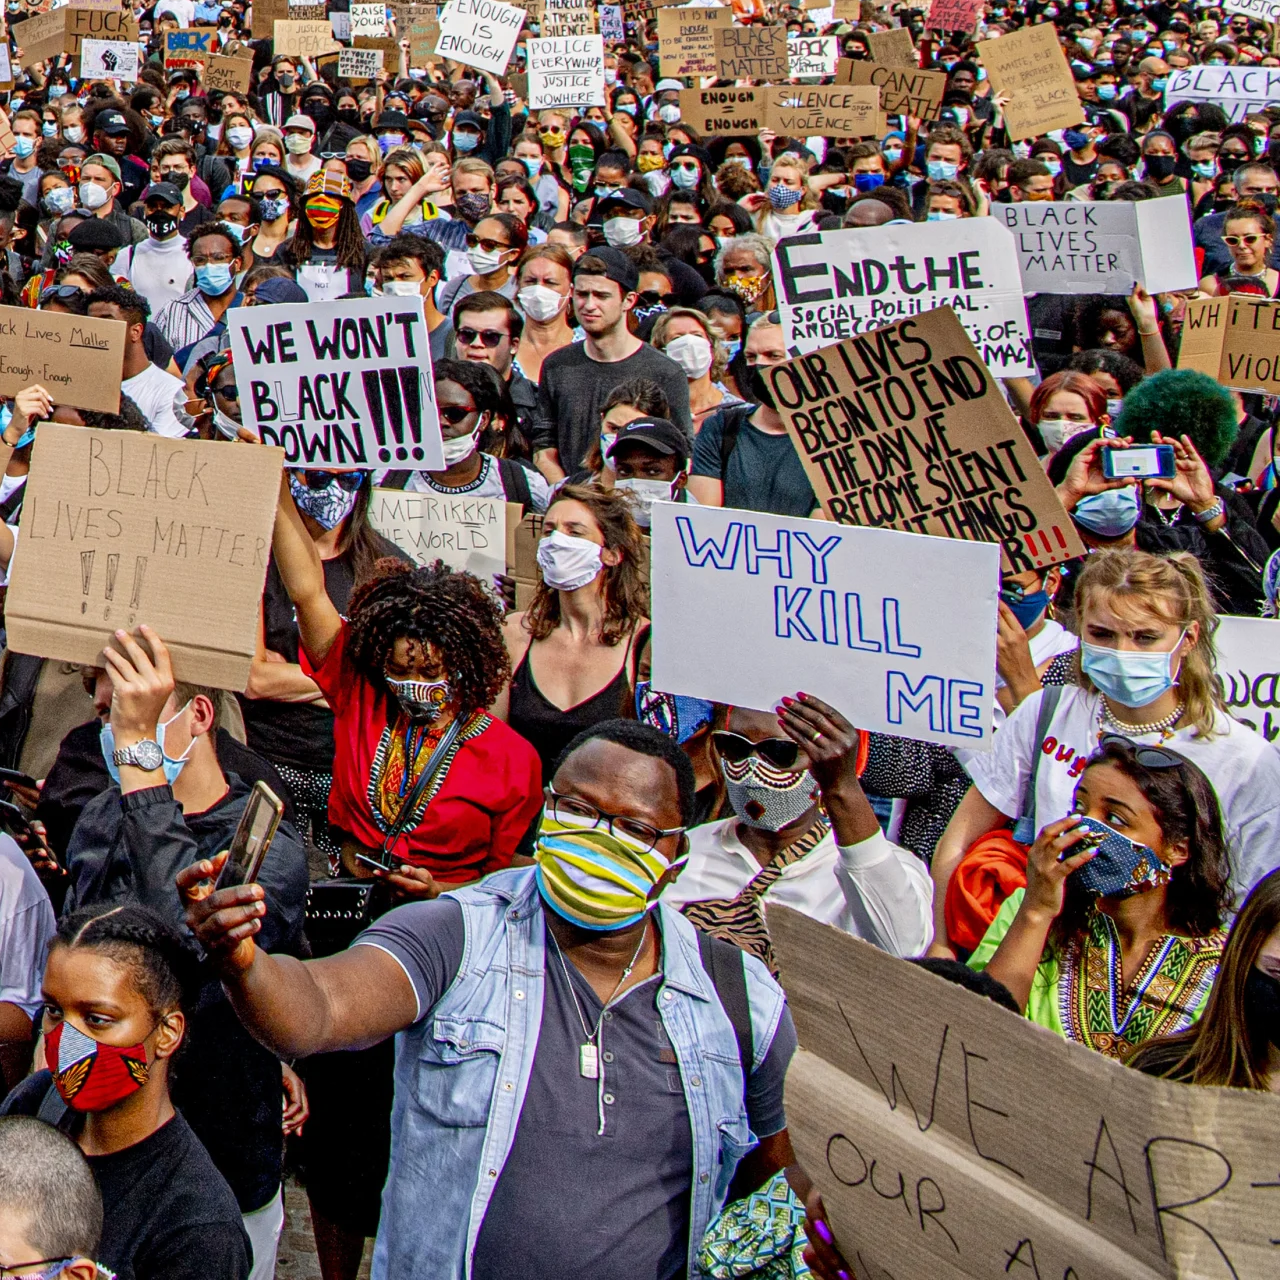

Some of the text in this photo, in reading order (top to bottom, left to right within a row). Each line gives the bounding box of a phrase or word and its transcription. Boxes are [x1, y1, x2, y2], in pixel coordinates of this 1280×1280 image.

[76, 10, 130, 32] FUCK
[352, 6, 384, 17] RAISE
[353, 15, 384, 26] YOUR
[472, 23, 493, 39] IS
[723, 27, 782, 46] BLACK
[440, 35, 504, 62] ENOUGH
[734, 44, 775, 57] LIVES
[720, 58, 785, 76] MATTER
[870, 68, 936, 93] CANT
[700, 91, 754, 104] ENOUGH
[778, 91, 853, 108] SILENCE
[705, 117, 758, 130] ENOUGH
[1005, 206, 1098, 227] BLACK
[1020, 232, 1097, 253] LIVES
[1026, 254, 1118, 273] MATTER
[24, 321, 60, 342] Lives
[240, 312, 418, 364] WE WON'T
[0, 356, 72, 384] Enough Enough
[772, 323, 932, 409] OUR LIVES
[792, 354, 987, 454] BEGIN TO END
[812, 416, 962, 495] THE DAY WE
[88, 437, 209, 506] BLACK
[930, 442, 1028, 503] SILENT
[30, 498, 266, 568] LIVES MATTER
[402, 529, 488, 549] WORLD
[677, 516, 842, 583] WHY
[775, 585, 921, 658] KILL
[887, 671, 984, 739] ME
[838, 1000, 1024, 1178] WE
[826, 1132, 960, 1252] OUR
